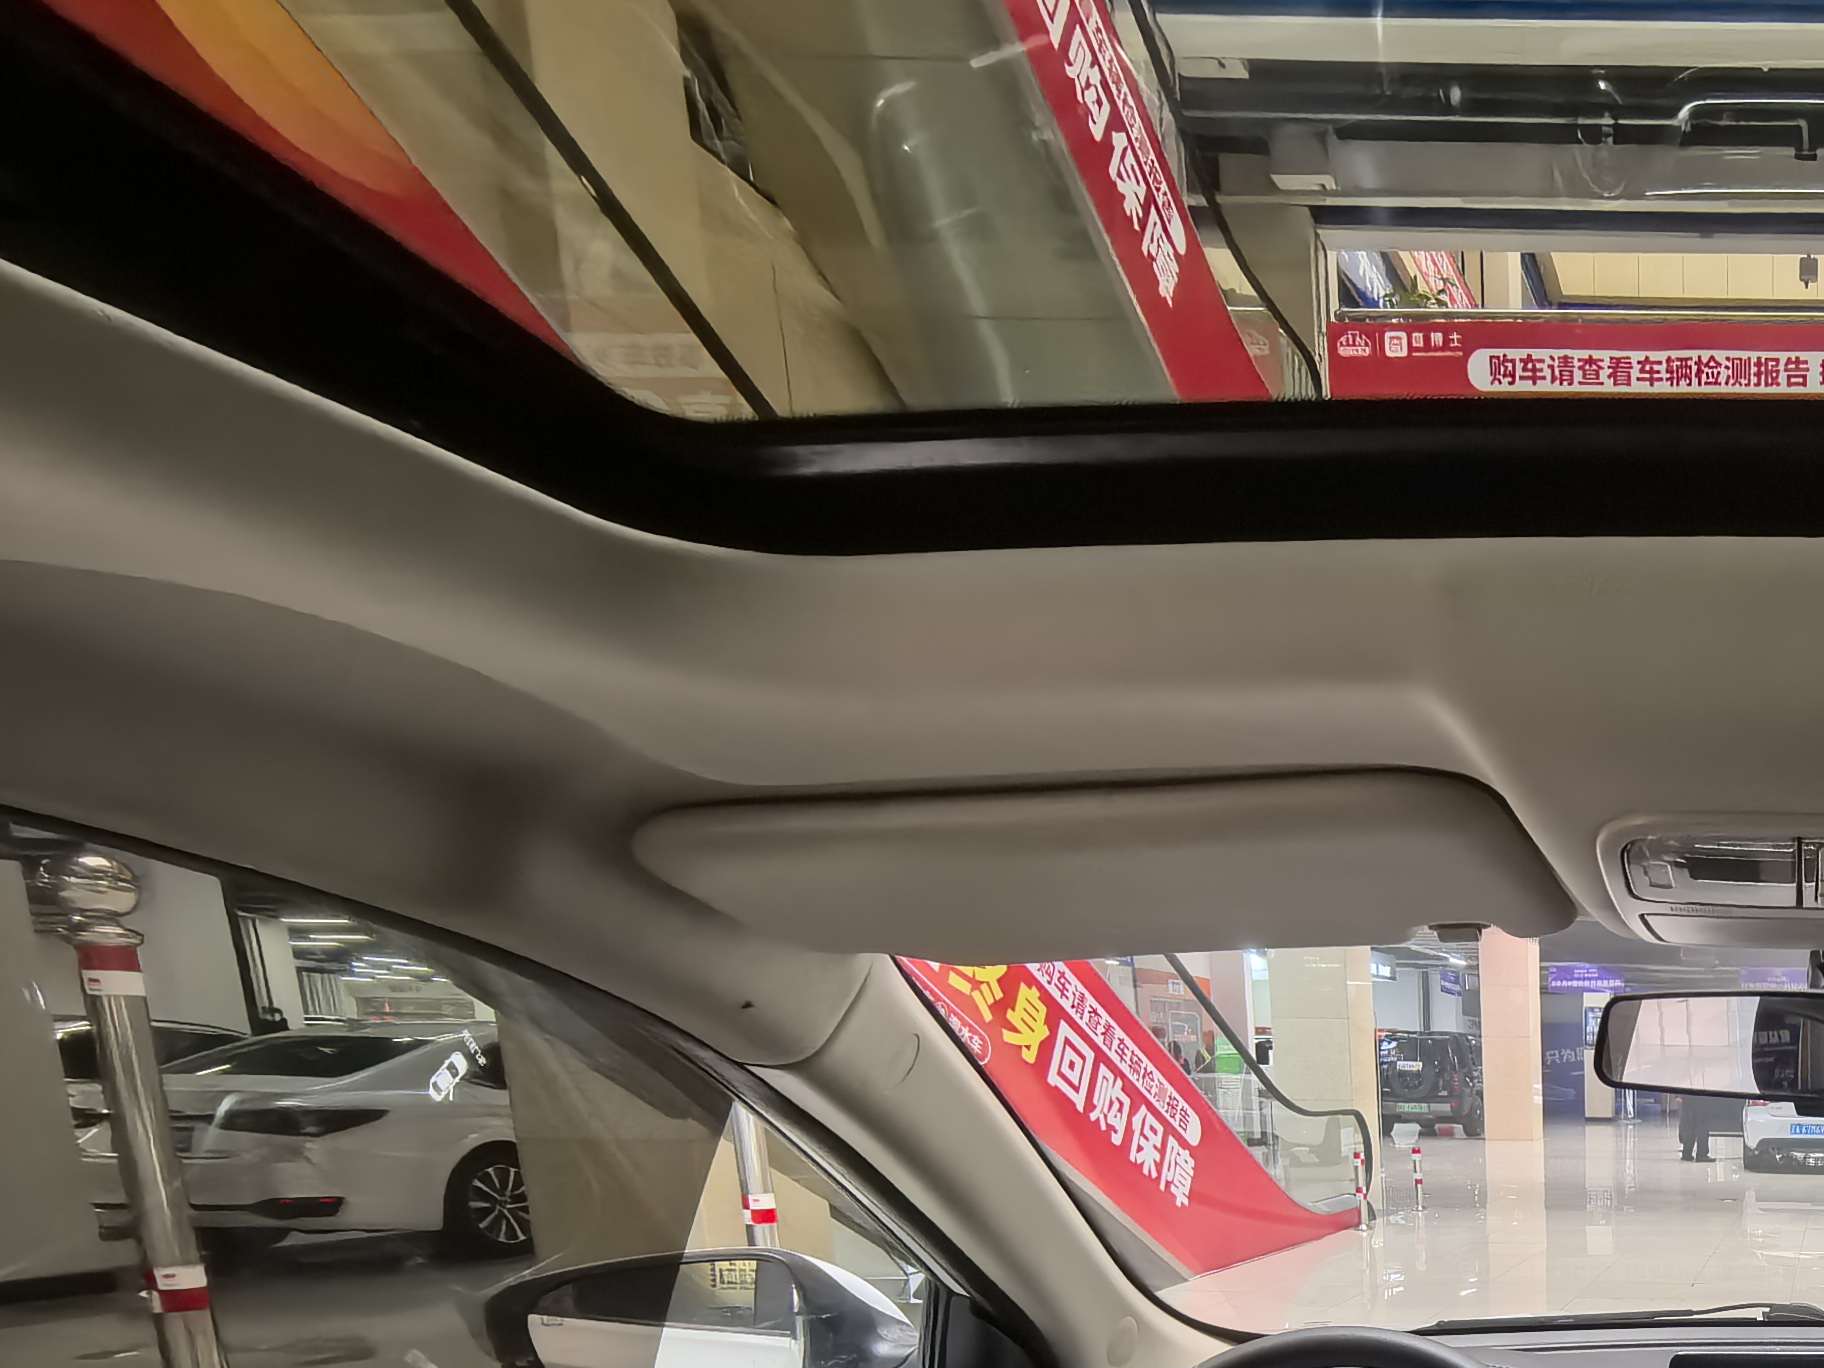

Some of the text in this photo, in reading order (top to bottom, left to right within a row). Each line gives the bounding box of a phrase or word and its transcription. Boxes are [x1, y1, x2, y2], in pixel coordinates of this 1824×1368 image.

[1488, 353, 1810, 388] 购车请查看车辆检测报告
